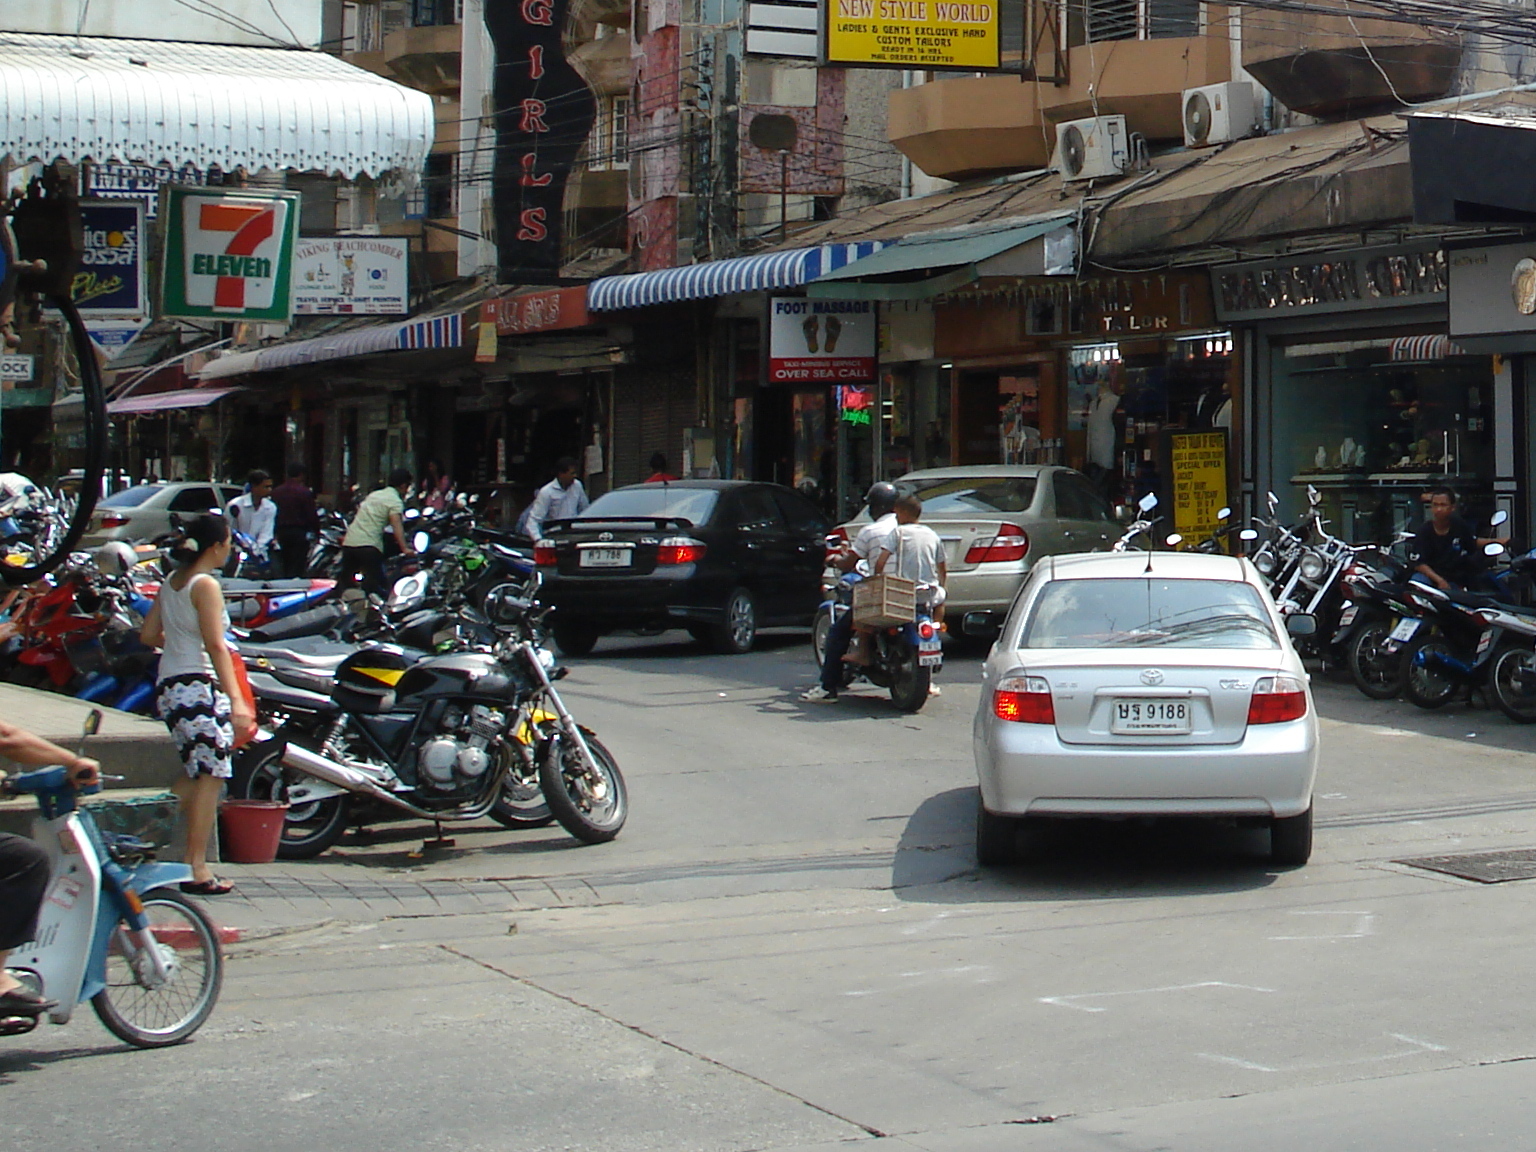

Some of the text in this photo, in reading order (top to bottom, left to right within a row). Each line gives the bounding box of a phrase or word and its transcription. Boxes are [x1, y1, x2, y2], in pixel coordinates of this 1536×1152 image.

[879, 0, 927, 20] STYLE
[935, 2, 992, 23] WORLD
[837, 24, 867, 33] LADIES
[883, 26, 910, 35] GENTS
[915, 27, 959, 37] EXCLUSIVE
[963, 29, 986, 38] HAND
[877, 36, 952, 47] CUSTOM TAILORS
[200, 205, 275, 308] 7
[776, 301, 870, 314] FOOT MASSAGE
[775, 369, 868, 379] OVER SEA CALL
[1147, 704, 1185, 719] 9188
